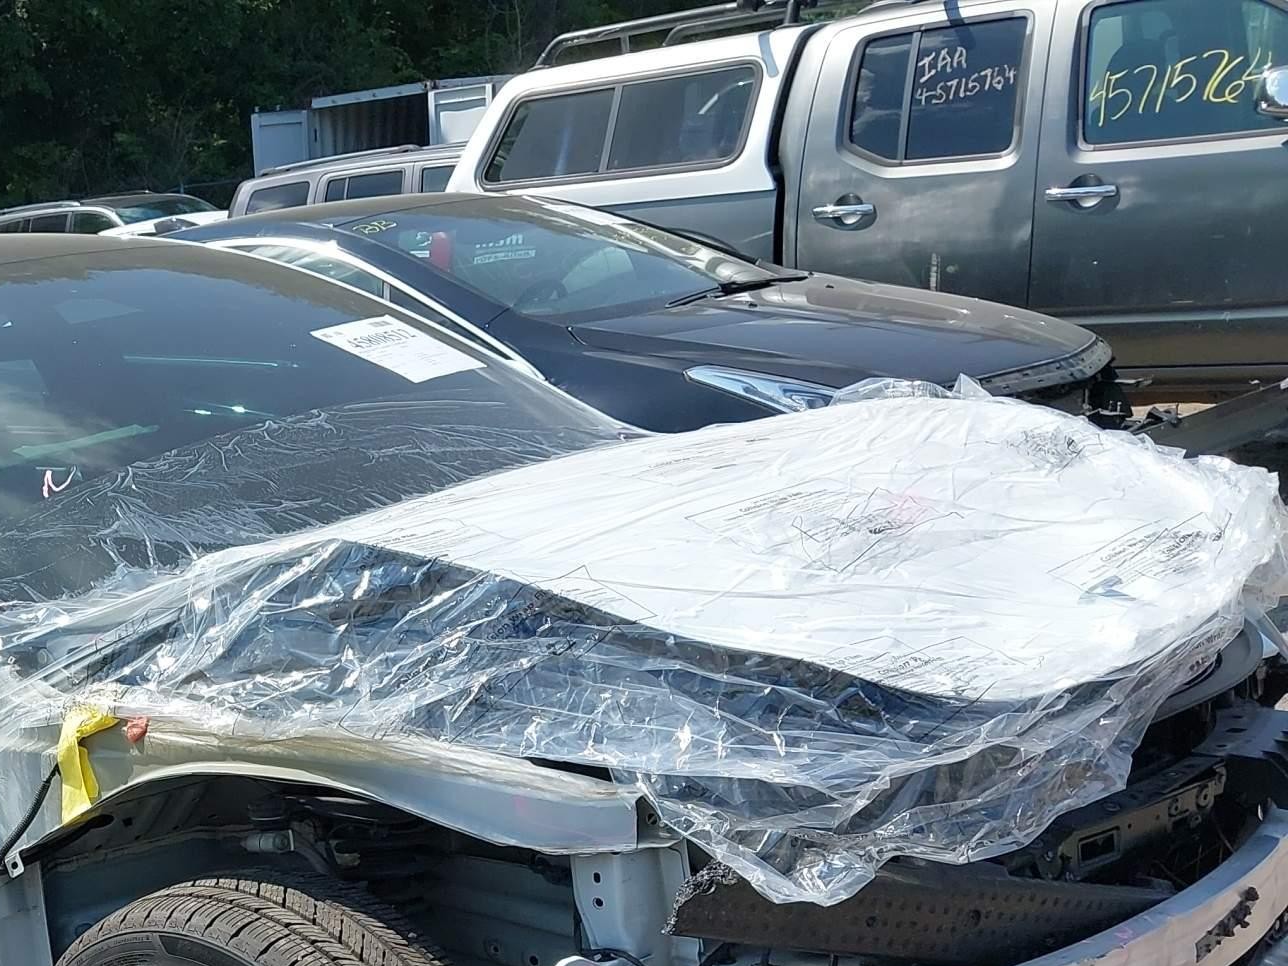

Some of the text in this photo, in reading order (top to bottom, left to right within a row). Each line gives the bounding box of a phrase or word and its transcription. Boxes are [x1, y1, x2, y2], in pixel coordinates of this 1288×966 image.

[918, 46, 967, 83] IAA
[915, 65, 1017, 106] 45715764
[1090, 48, 1272, 127] 45715764
